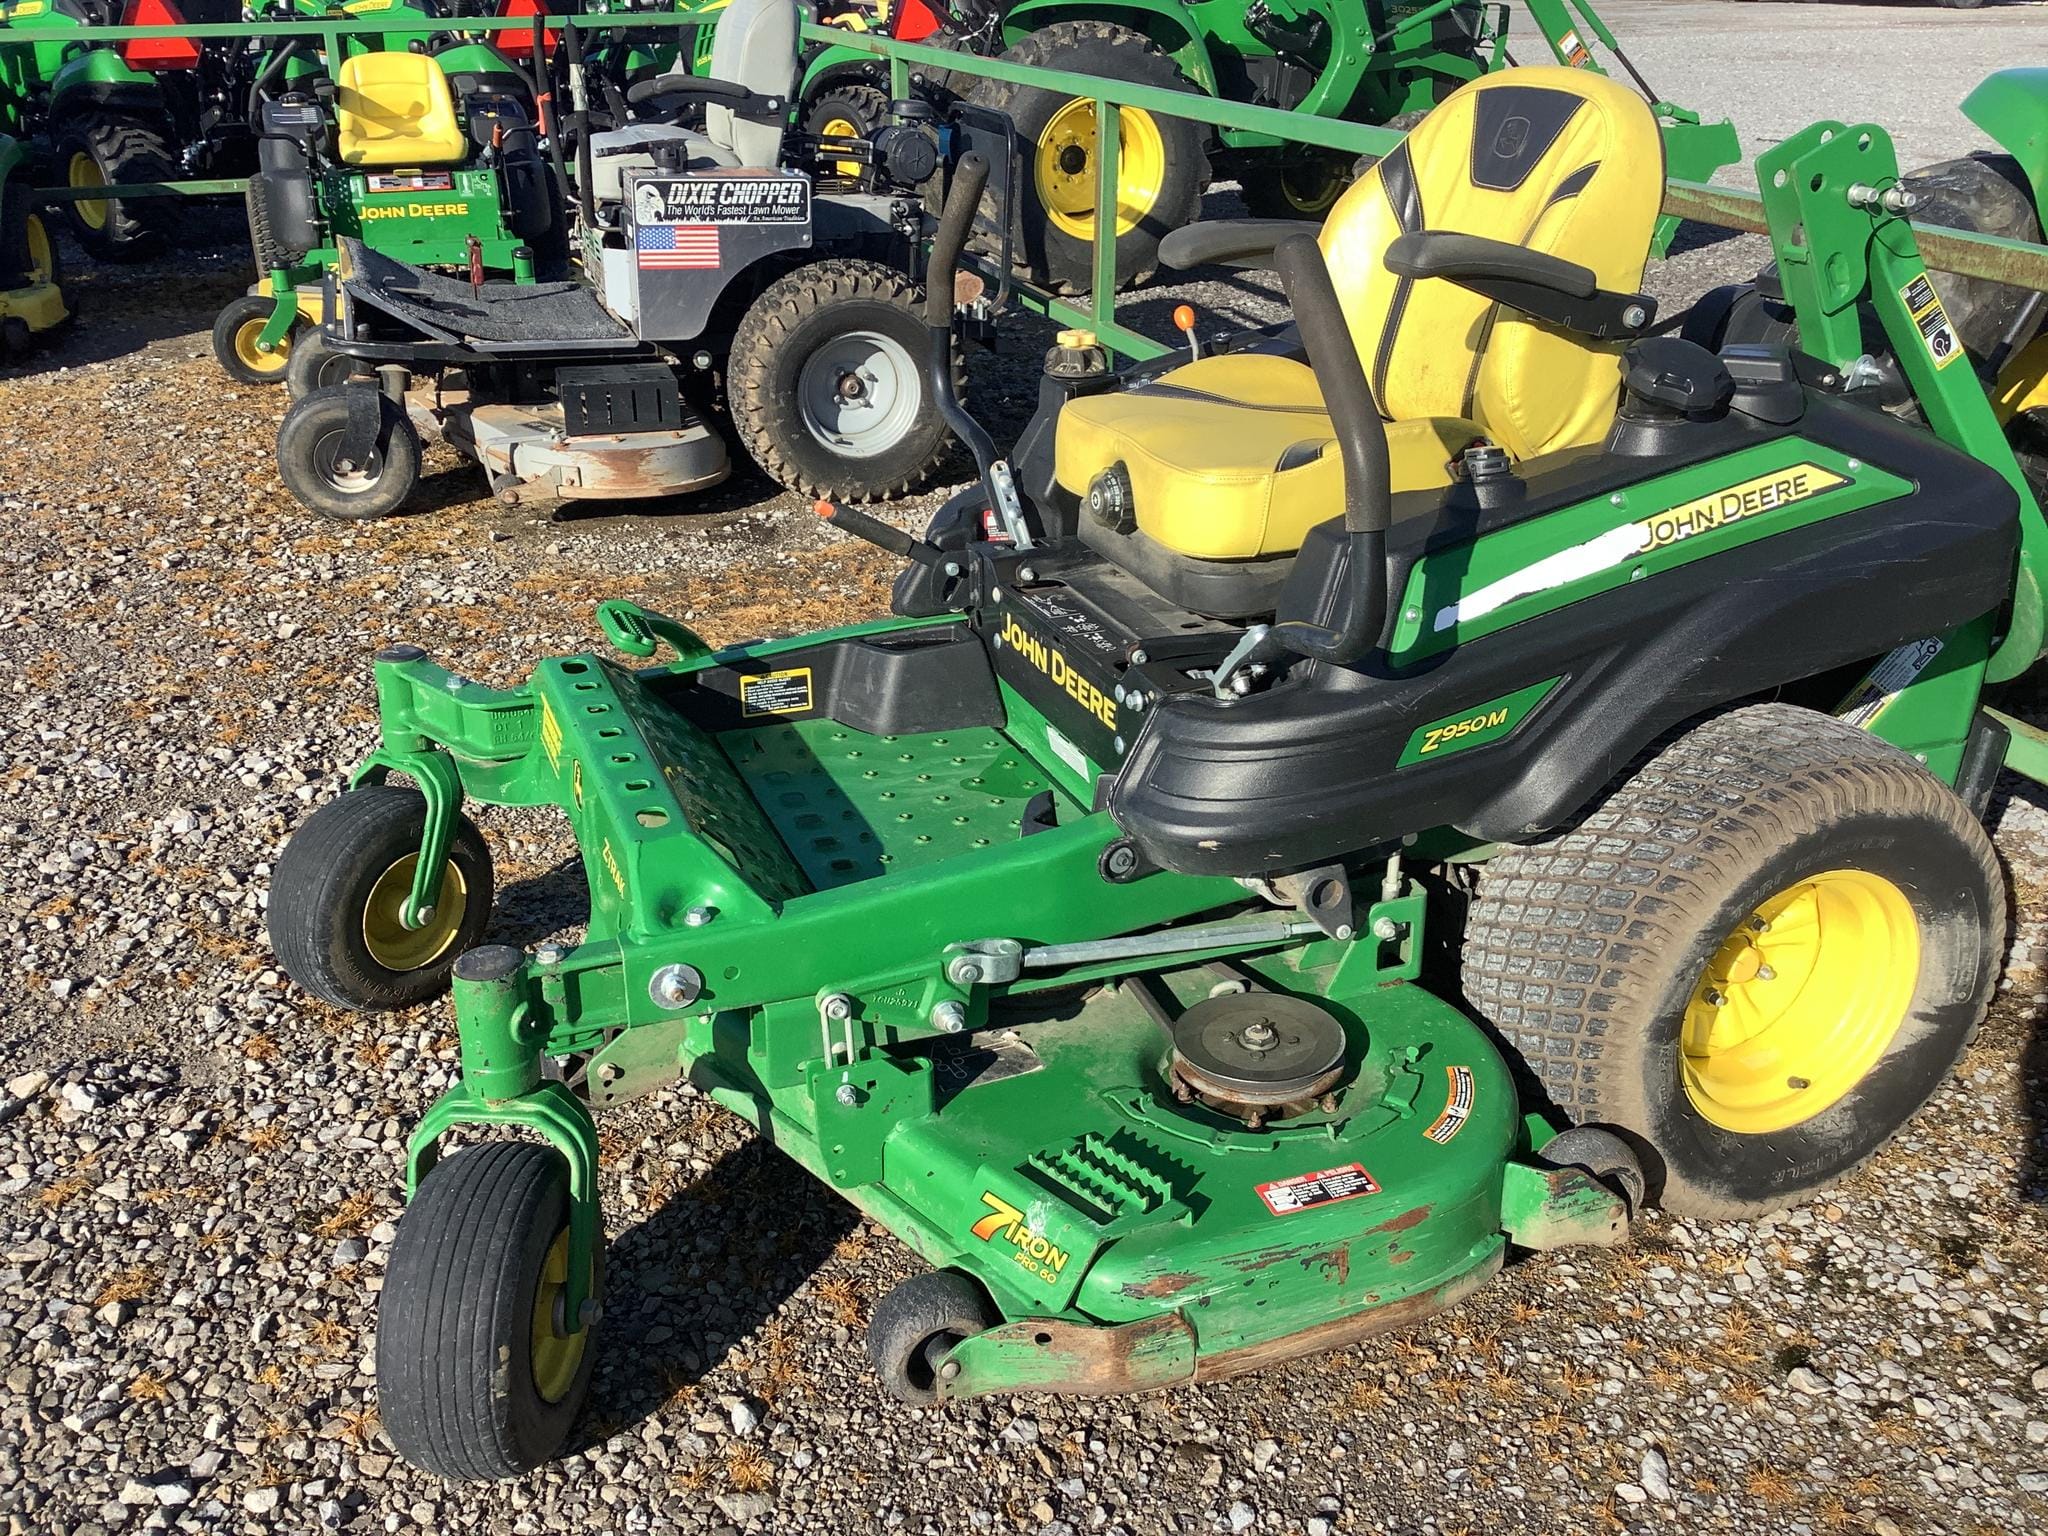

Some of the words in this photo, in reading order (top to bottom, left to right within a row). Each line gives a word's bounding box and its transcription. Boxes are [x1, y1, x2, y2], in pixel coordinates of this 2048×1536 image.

[358, 206, 405, 220] JOHN
[408, 203, 469, 217] DEERE
[667, 183, 716, 205] DIXIE
[667, 205, 682, 215] The
[684, 204, 715, 216] World's
[717, 203, 746, 215] Fastest
[749, 204, 770, 214] Lawn
[772, 205, 800, 215] Mower
[1640, 504, 1715, 549] JOHN
[1720, 473, 1809, 520] DEERE
[1001, 612, 1048, 674] JOHN
[1051, 648, 1117, 732] DEERE
[1420, 707, 1508, 754] Z950M
[603, 837, 626, 899] ZTRAK
[971, 1190, 1026, 1242] 7
[1003, 1219, 1070, 1273] IRON
[1014, 1251, 1039, 1273] PRO
[1039, 1267, 1058, 1284] 60
